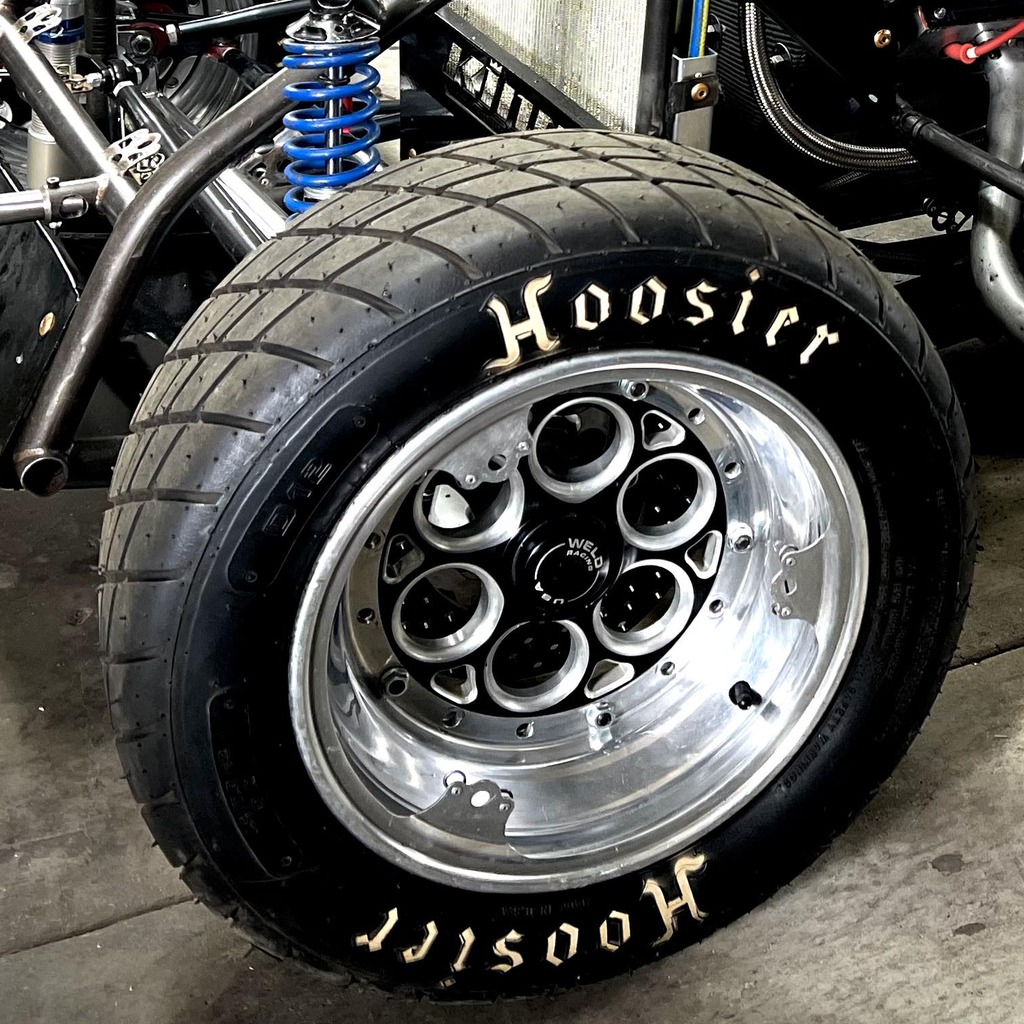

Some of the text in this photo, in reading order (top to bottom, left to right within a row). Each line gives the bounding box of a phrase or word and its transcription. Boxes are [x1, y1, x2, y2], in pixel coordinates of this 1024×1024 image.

[484, 267, 840, 371] Hoosier
[566, 549, 594, 572] RACING
[568, 537, 604, 569] WELD
[355, 854, 709, 988] Hoosier
